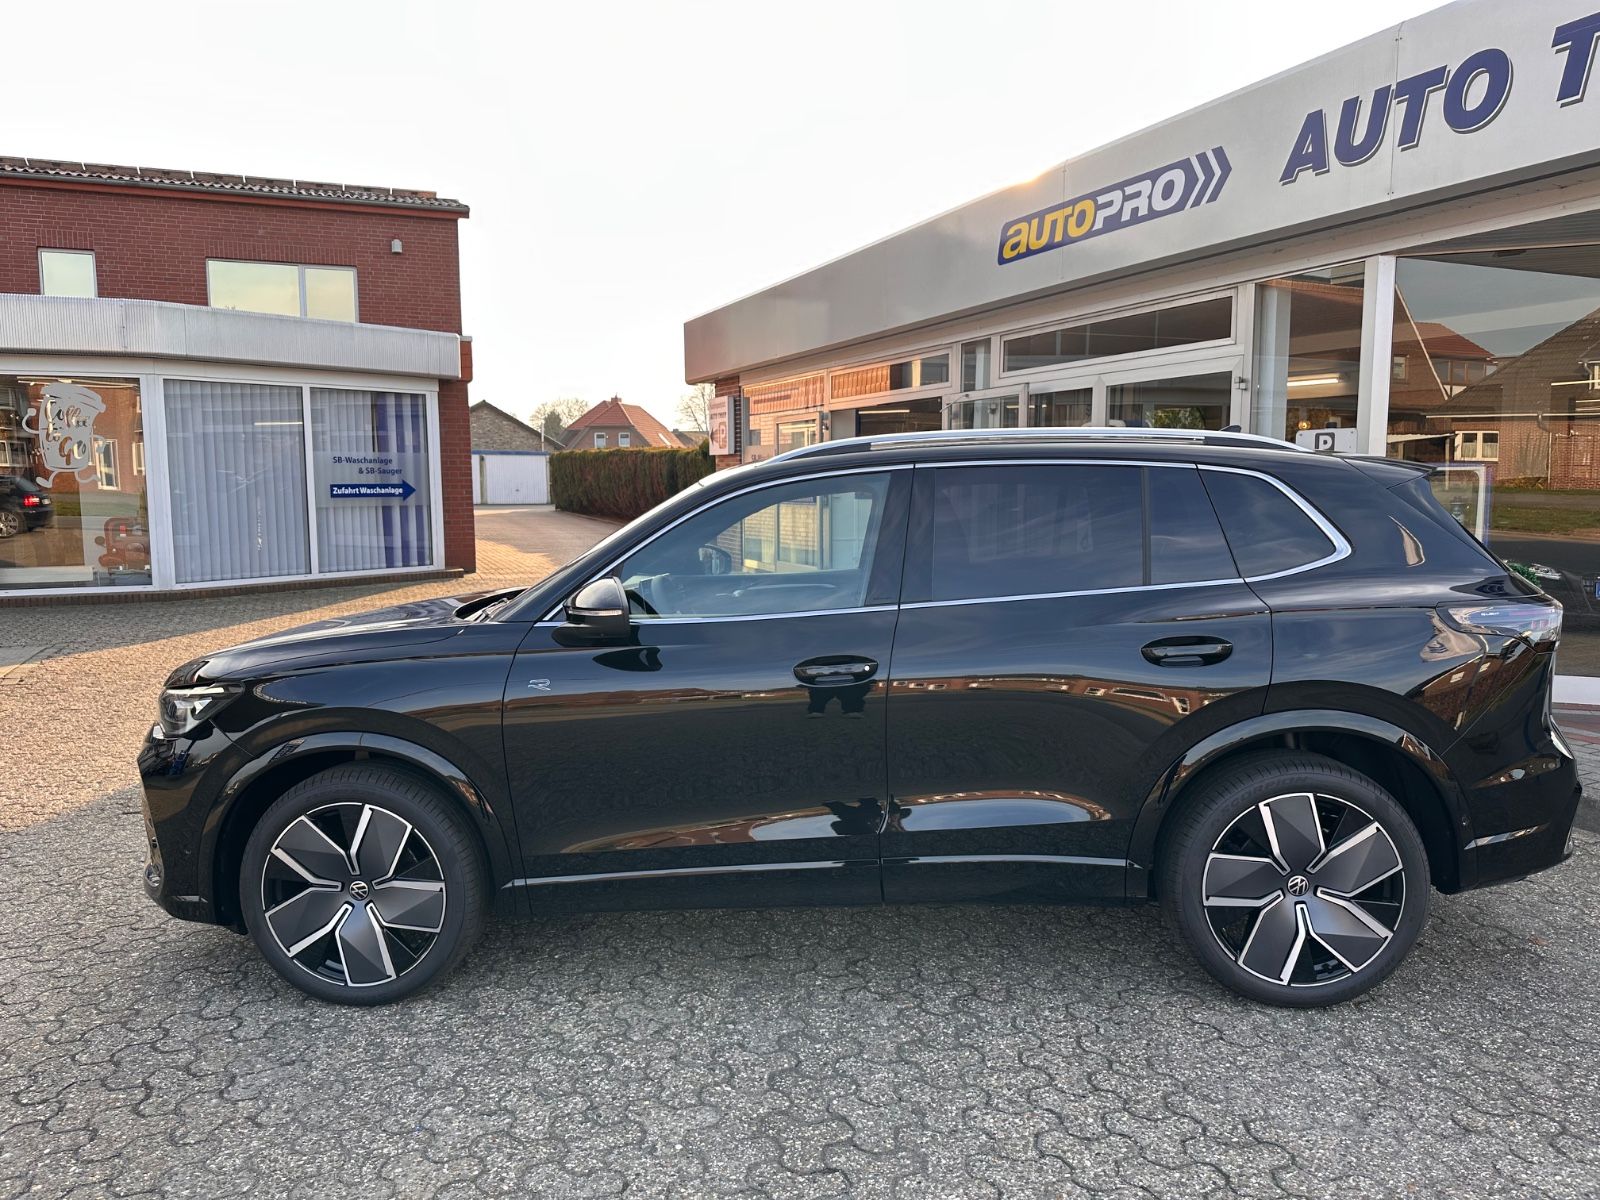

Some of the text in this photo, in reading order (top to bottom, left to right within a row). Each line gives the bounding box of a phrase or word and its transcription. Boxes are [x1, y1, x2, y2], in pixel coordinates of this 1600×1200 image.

[1279, 48, 1513, 186] AUTO
[333, 456, 393, 466] SB-Waschanlage
[365, 467, 402, 476] SB-Sauger
[332, 486, 403, 495] Zufahrt Waschanlage
